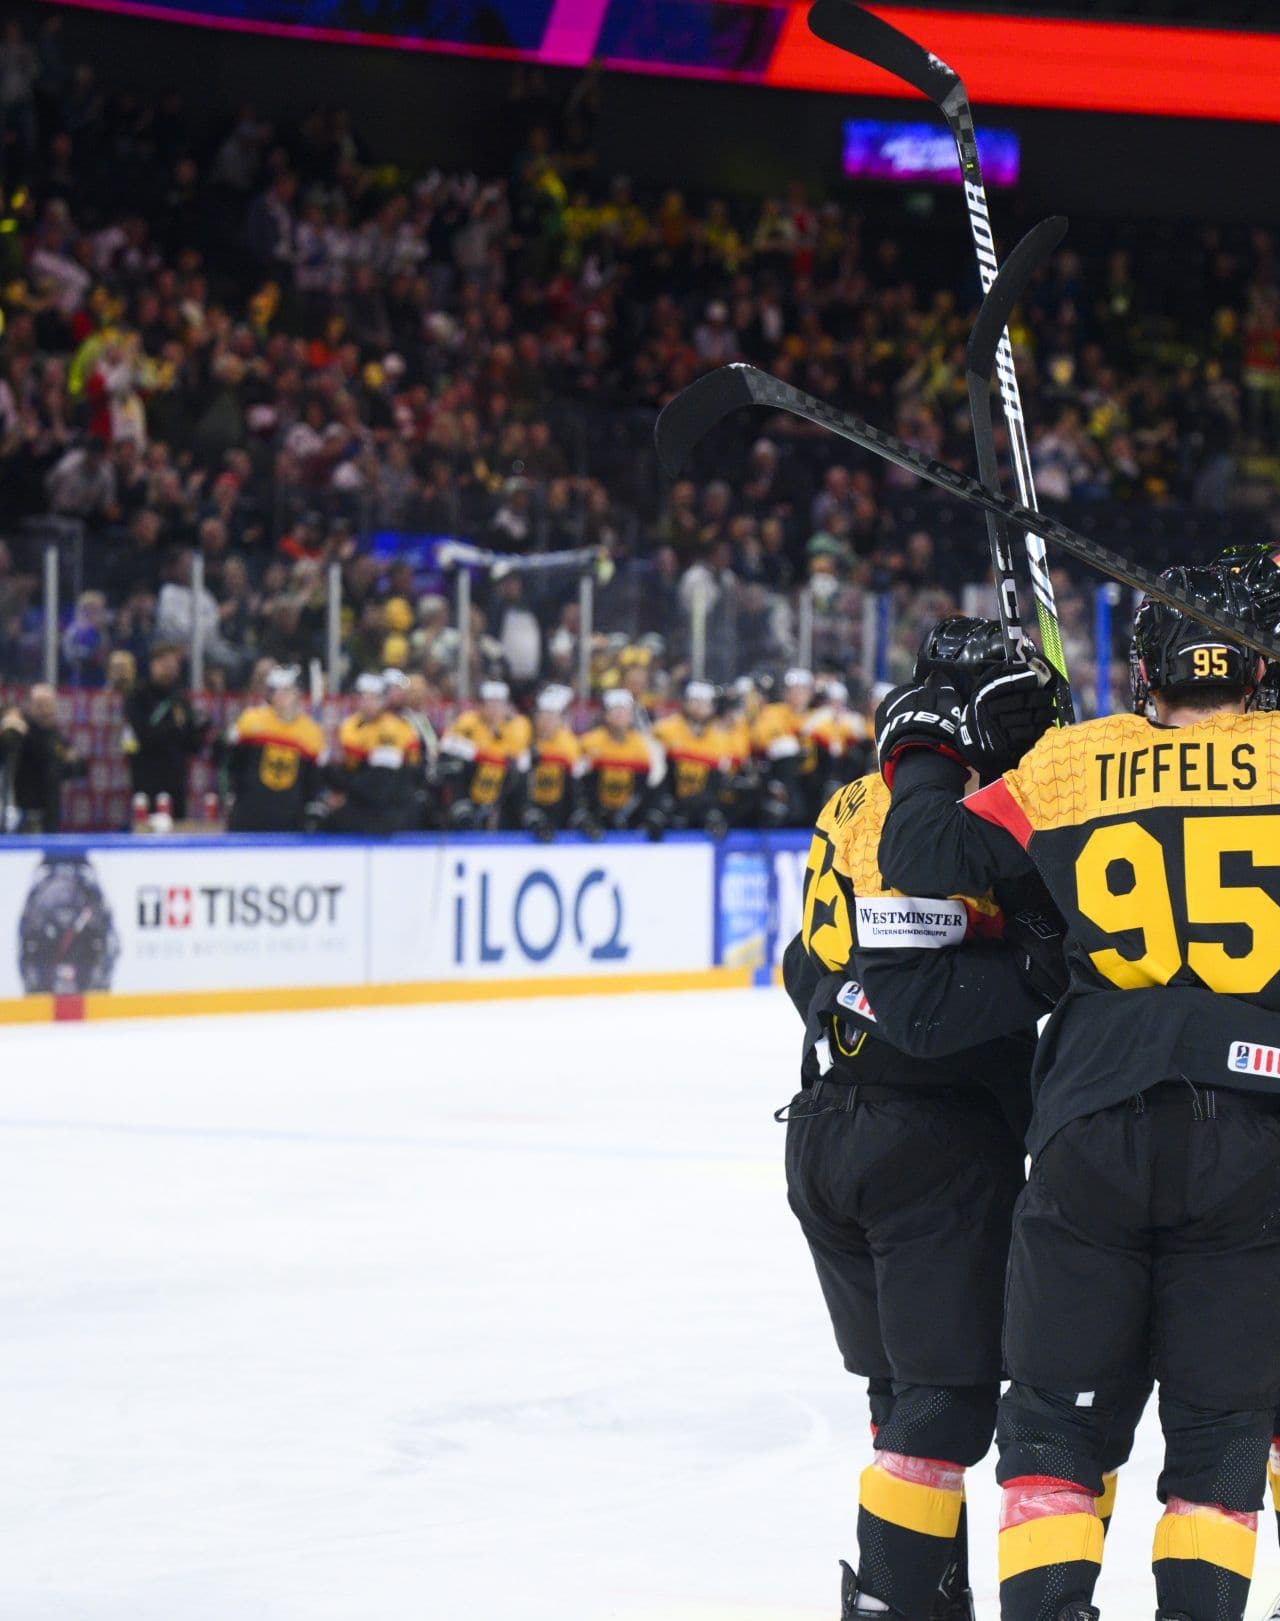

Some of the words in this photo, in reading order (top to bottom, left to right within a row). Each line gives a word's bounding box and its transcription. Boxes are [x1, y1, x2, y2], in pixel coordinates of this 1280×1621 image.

[964, 180, 1024, 424] WARIOR
[1193, 648, 1229, 677] 95
[1095, 742, 1258, 801] TIFFELS
[200, 884, 343, 927] TISSOT
[859, 908, 962, 927] WESTMINSTER
